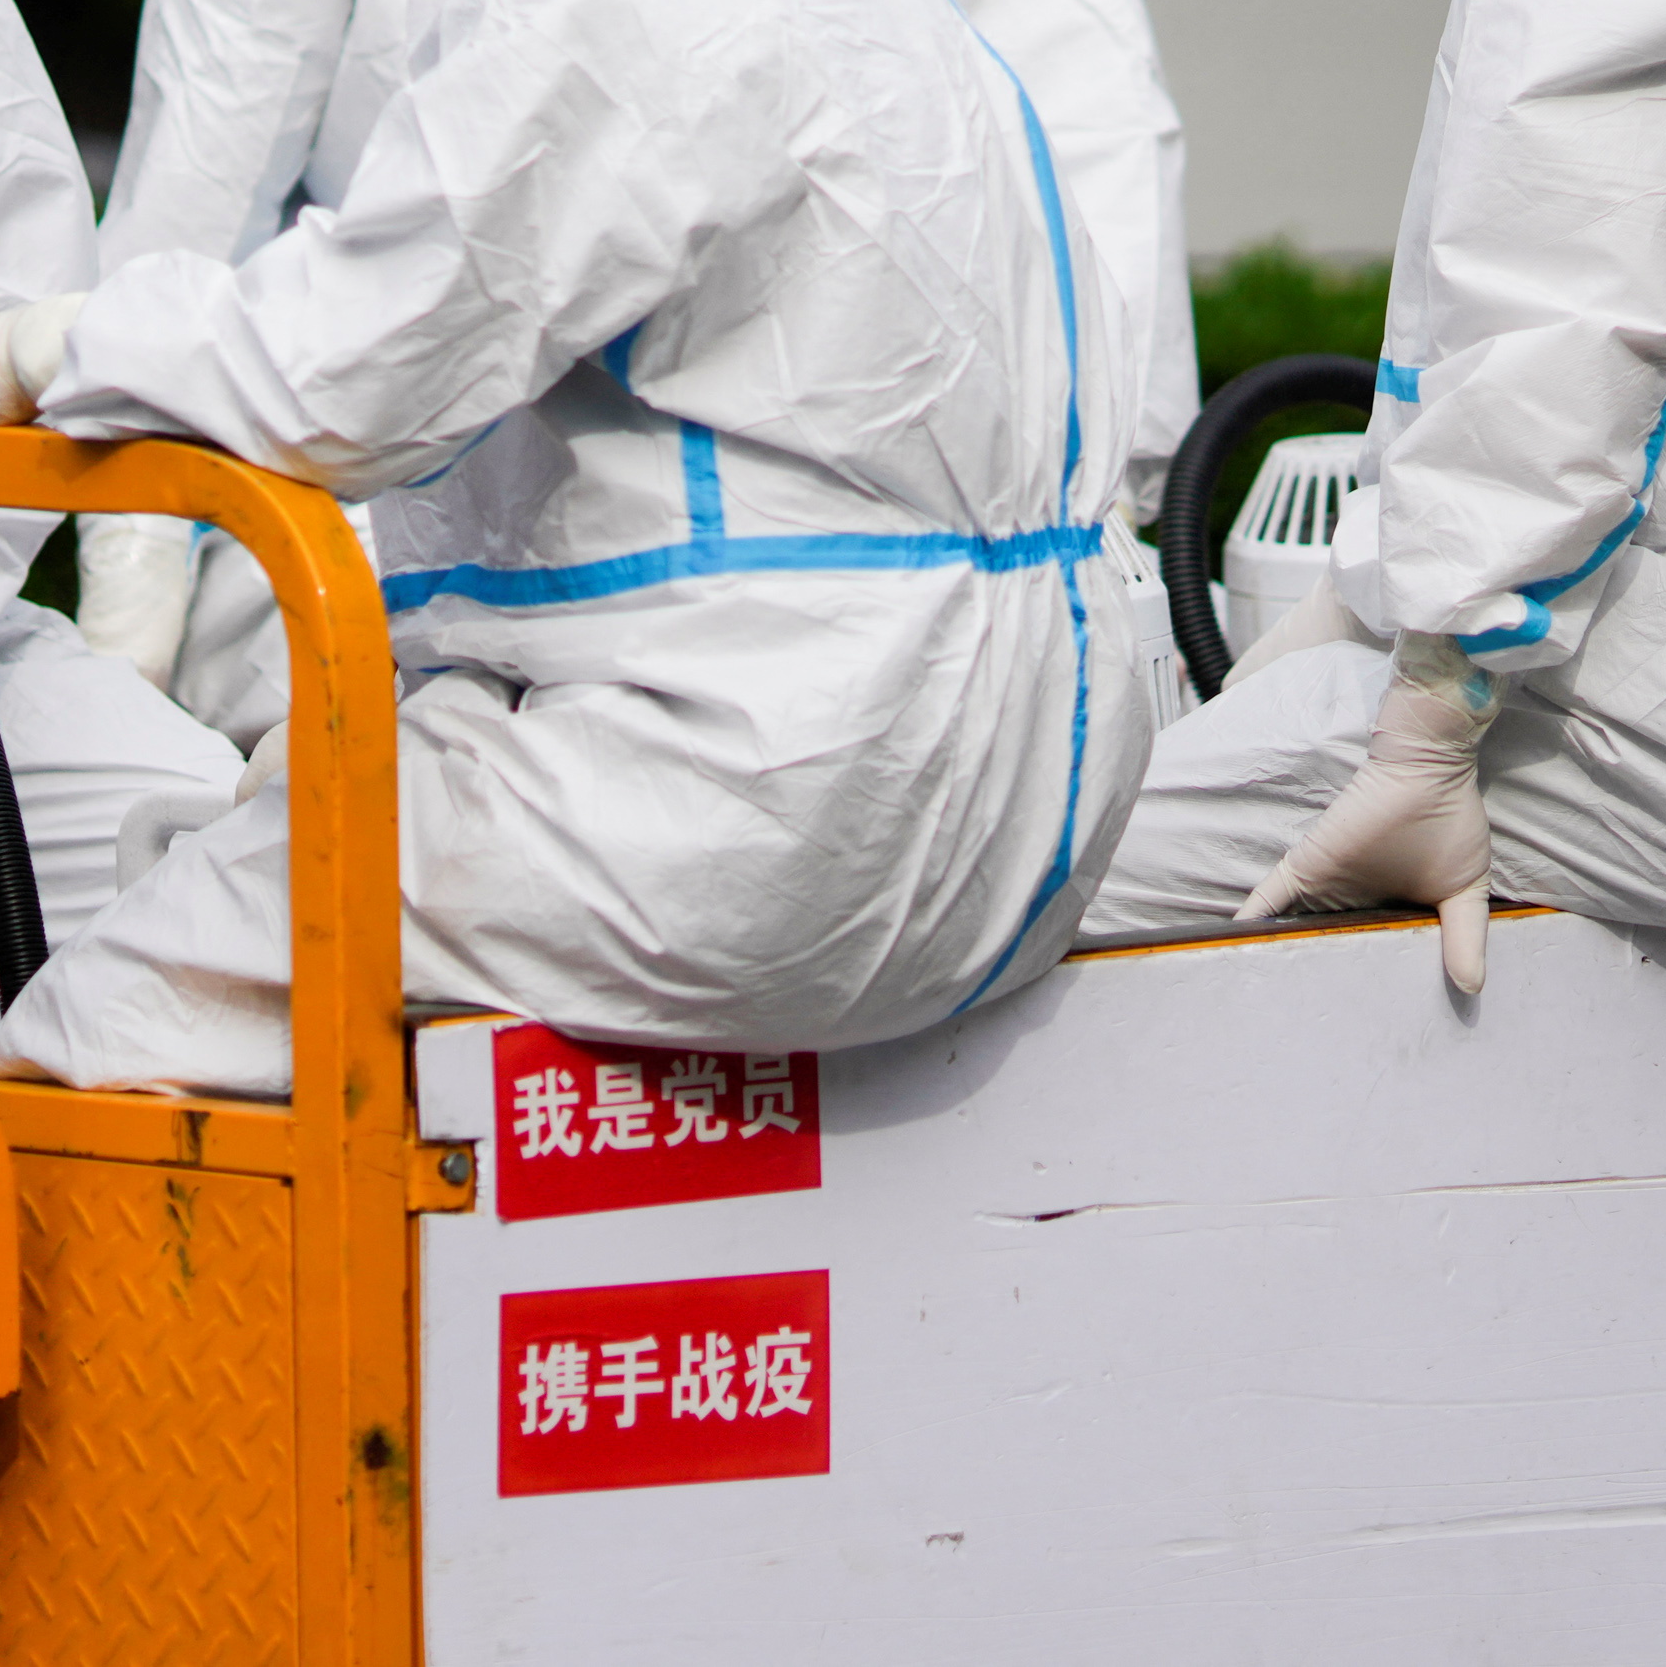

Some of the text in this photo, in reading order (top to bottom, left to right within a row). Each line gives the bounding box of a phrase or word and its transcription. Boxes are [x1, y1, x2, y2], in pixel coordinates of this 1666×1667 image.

[513, 1051, 802, 1160] 我是党员
[517, 1325, 813, 1436] 携手战疫
